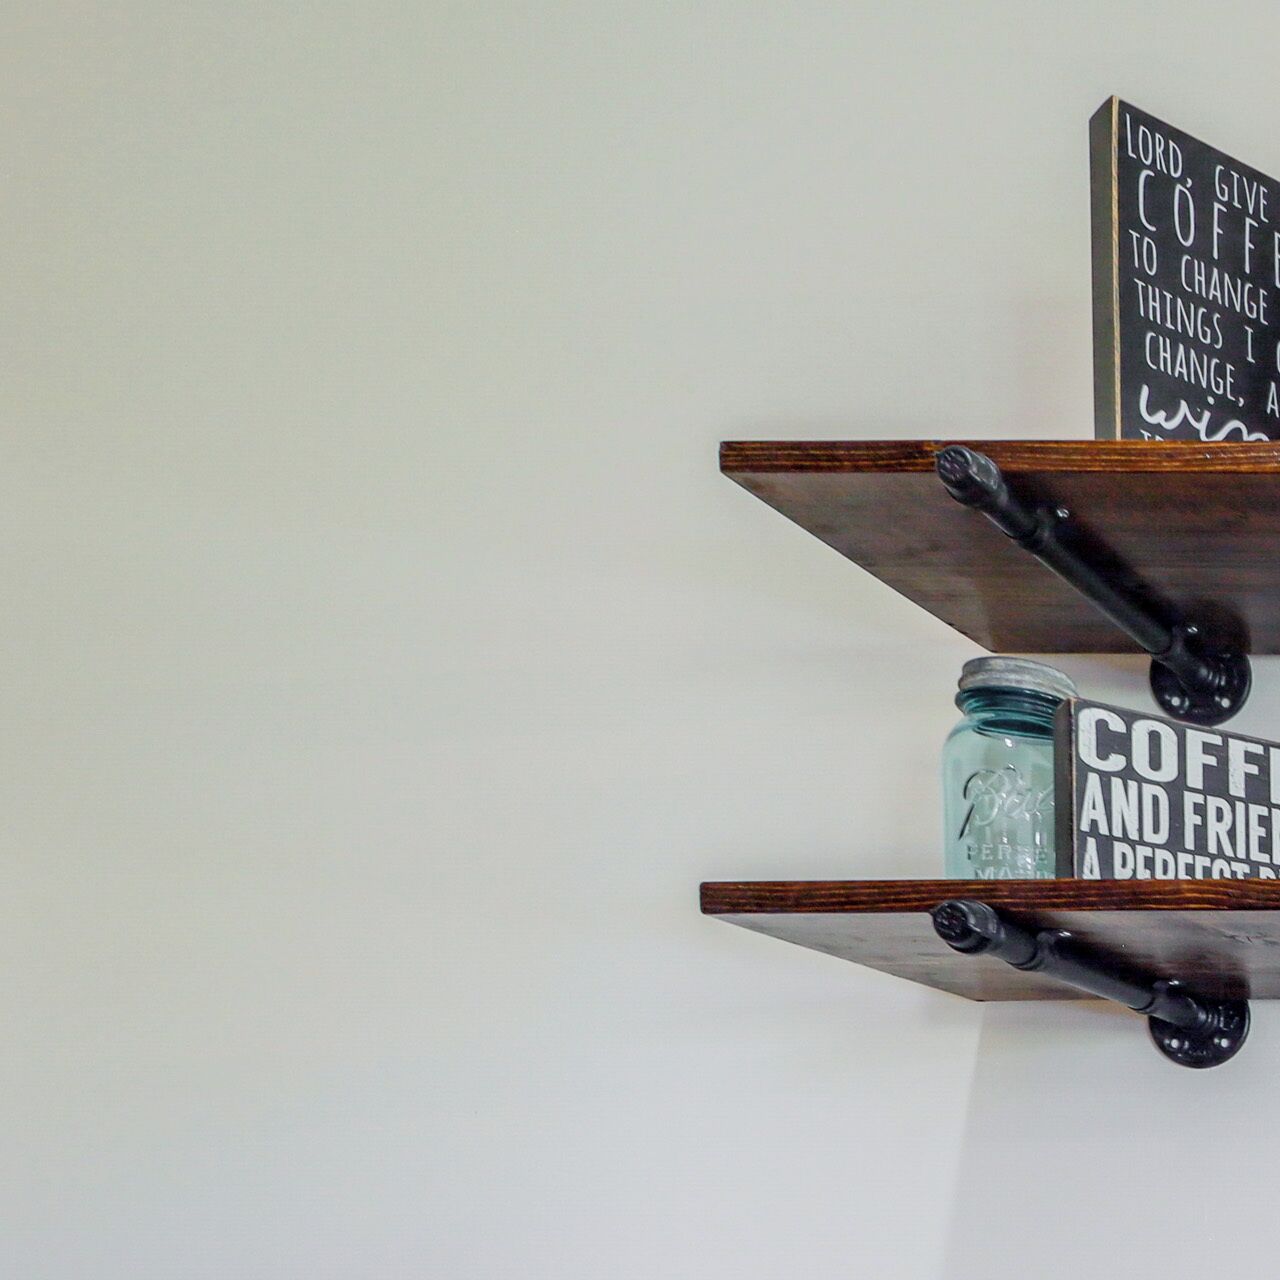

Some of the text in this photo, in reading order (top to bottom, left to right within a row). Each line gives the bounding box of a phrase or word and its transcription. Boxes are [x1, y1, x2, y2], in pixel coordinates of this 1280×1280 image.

[1125, 112, 1193, 188] LORD,
[1214, 164, 1270, 224] GIVE
[1128, 229, 1158, 277] TO
[1180, 254, 1269, 326] CHANGE
[1134, 278, 1224, 350] THINGS
[1244, 325, 1256, 364] I
[1145, 331, 1246, 408] CHANGE,
[1079, 771, 1171, 846] AND
